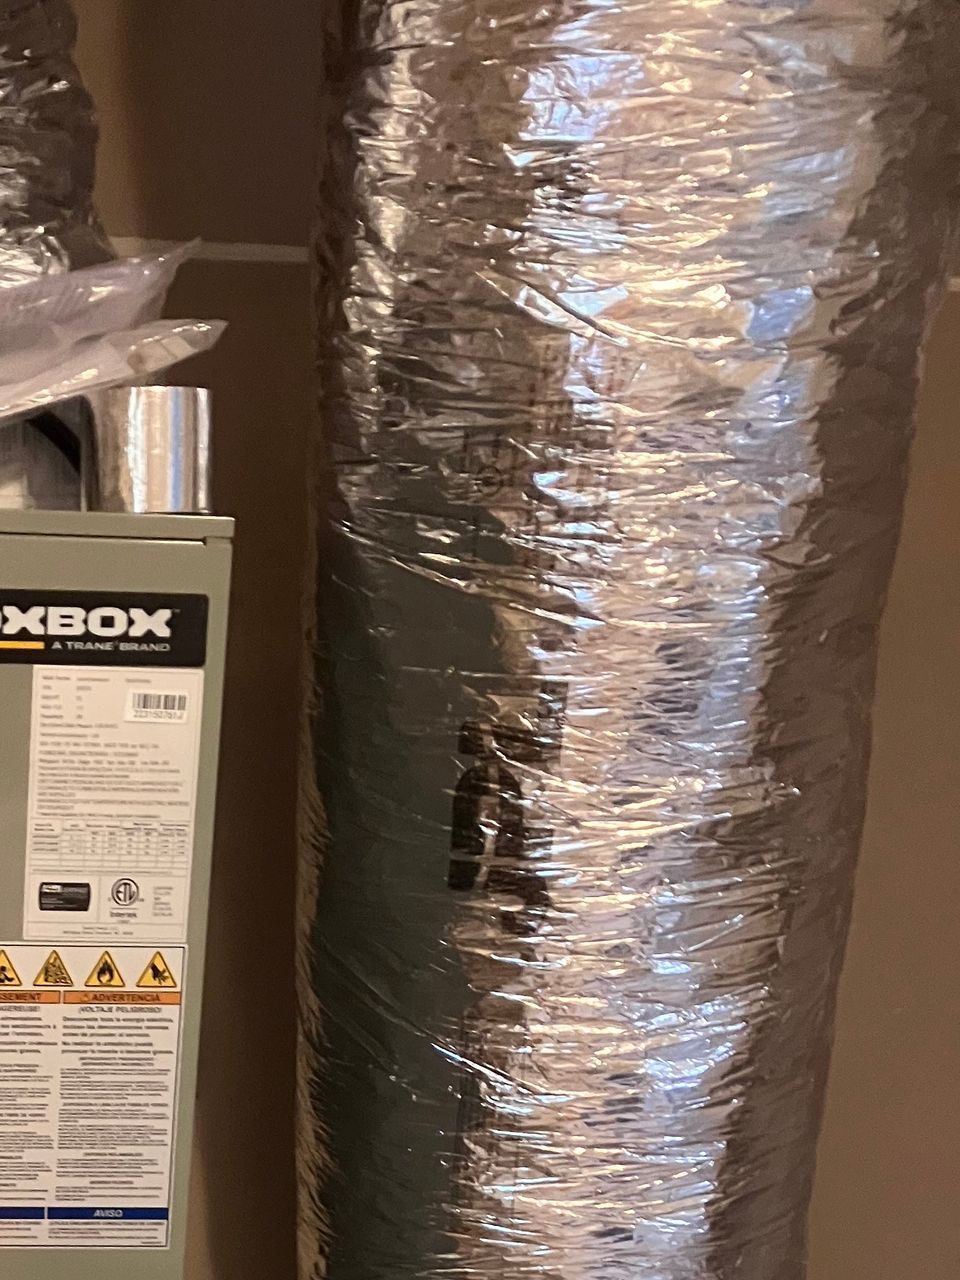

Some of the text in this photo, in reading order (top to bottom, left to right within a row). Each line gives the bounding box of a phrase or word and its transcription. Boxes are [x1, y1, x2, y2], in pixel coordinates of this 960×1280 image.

[51, 641, 62, 650] A
[119, 642, 171, 652] BRAND
[91, 993, 161, 1002] ADVERTENCIA
[93, 1209, 123, 1218] AVISO
